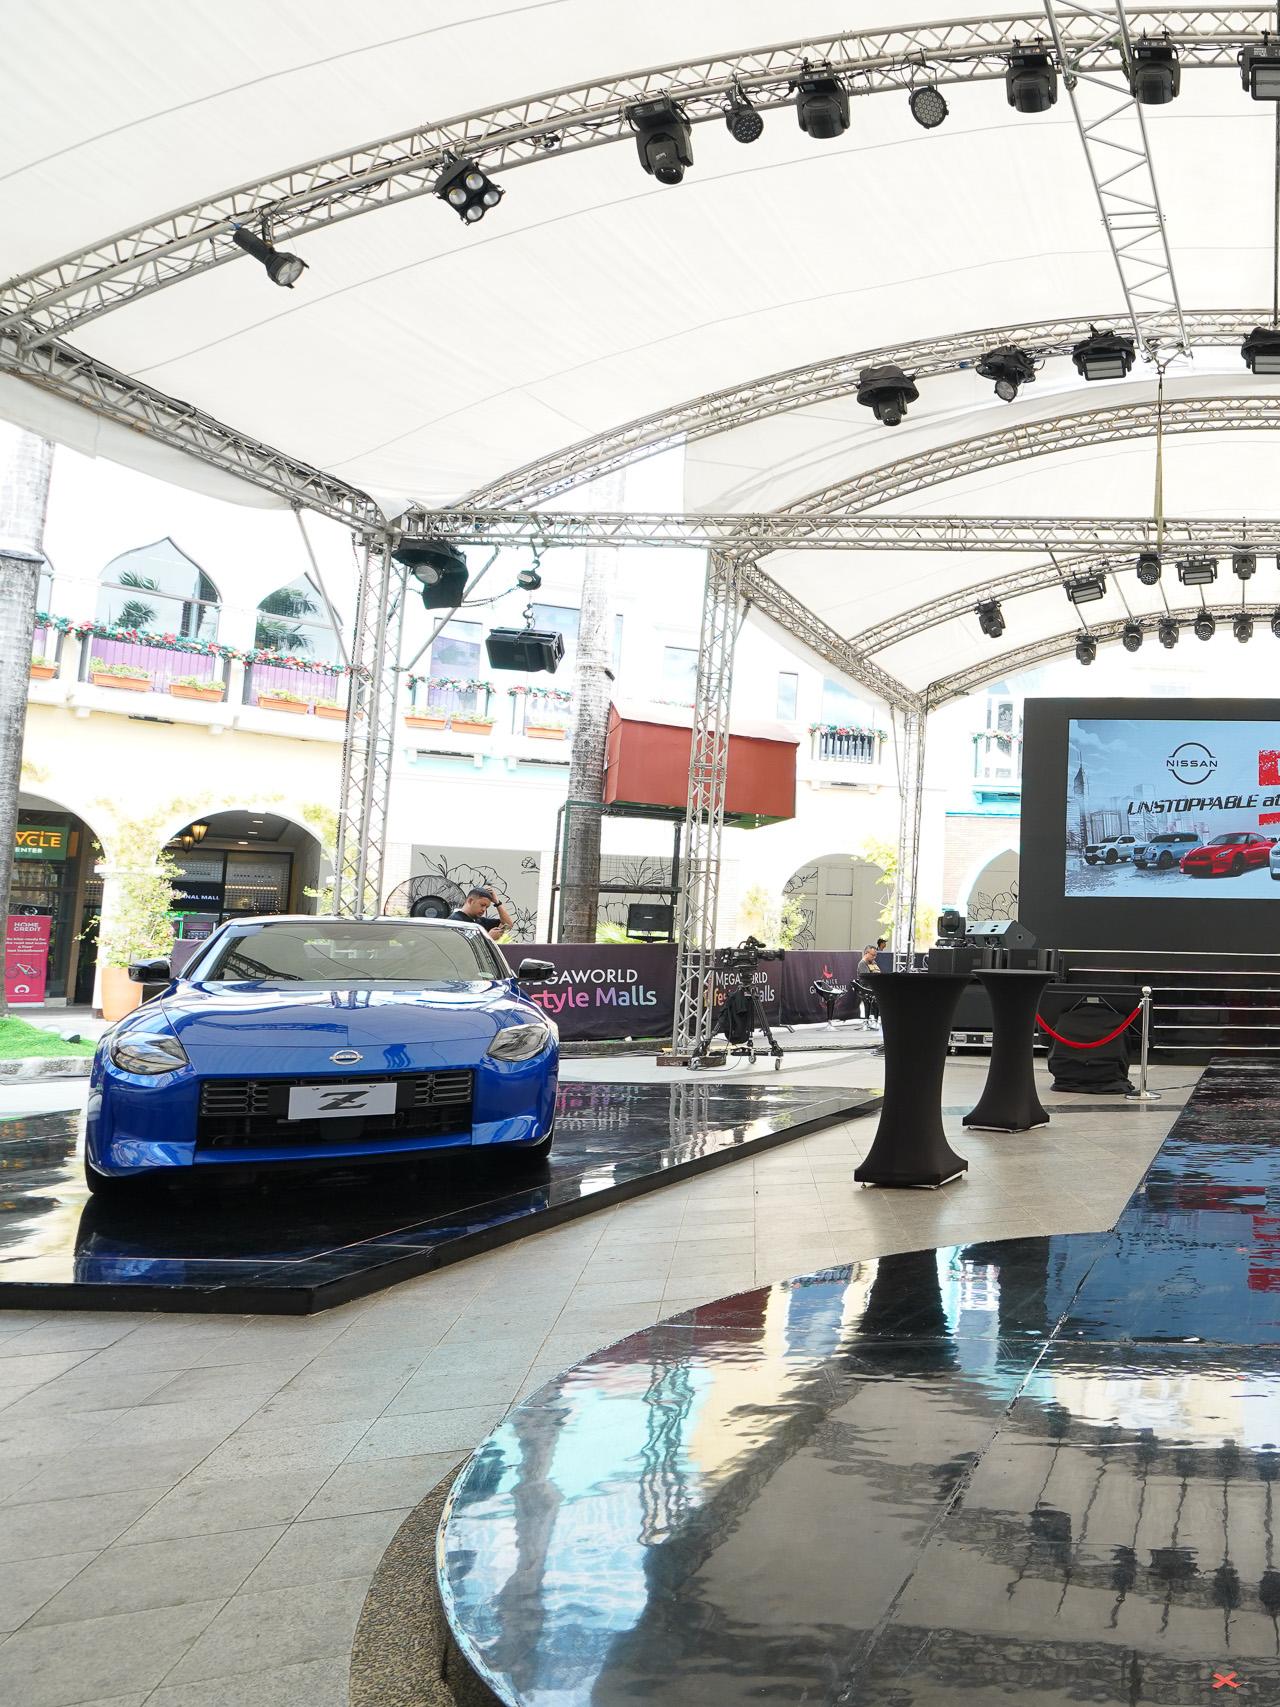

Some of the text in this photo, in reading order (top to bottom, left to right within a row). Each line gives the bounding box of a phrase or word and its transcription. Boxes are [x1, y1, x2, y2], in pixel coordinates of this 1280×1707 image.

[1166, 760, 1218, 768] NISSAN
[1127, 794, 1259, 816] UNSTOPPABLE
[596, 985, 657, 1008] Malls
[318, 1090, 370, 1111] Z
